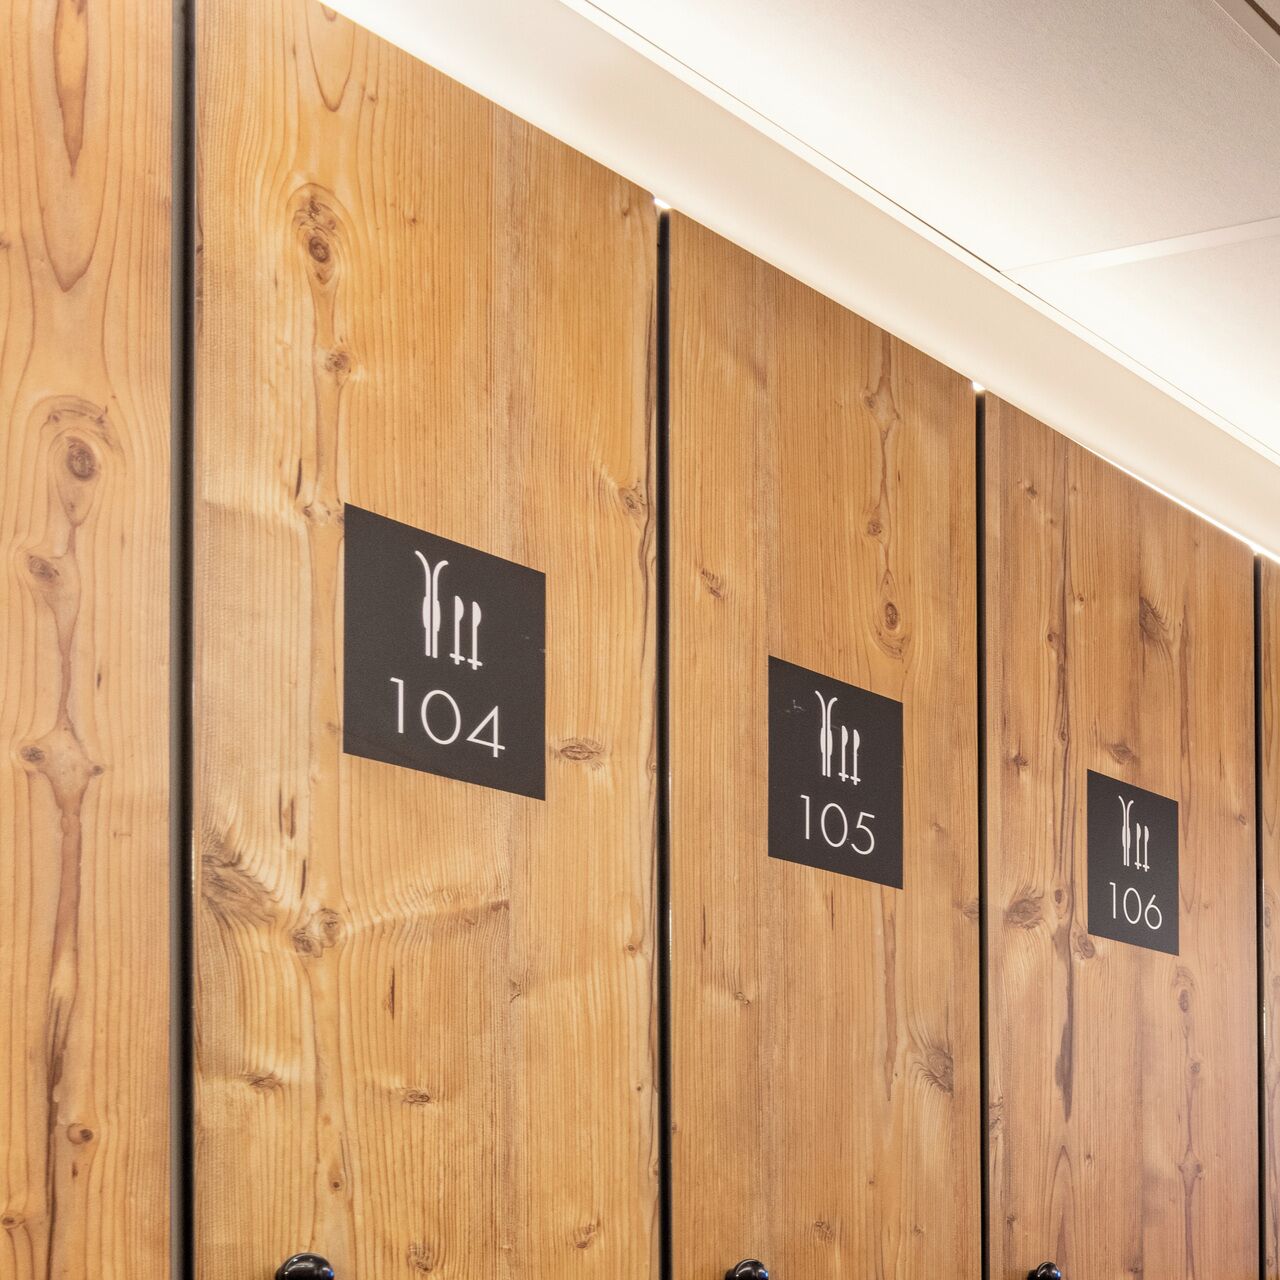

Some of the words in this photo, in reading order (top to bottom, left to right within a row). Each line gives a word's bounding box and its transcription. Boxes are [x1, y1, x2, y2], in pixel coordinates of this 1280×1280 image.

[390, 676, 507, 760] 104
[800, 794, 875, 856] 105
[1109, 881, 1163, 930] 106
